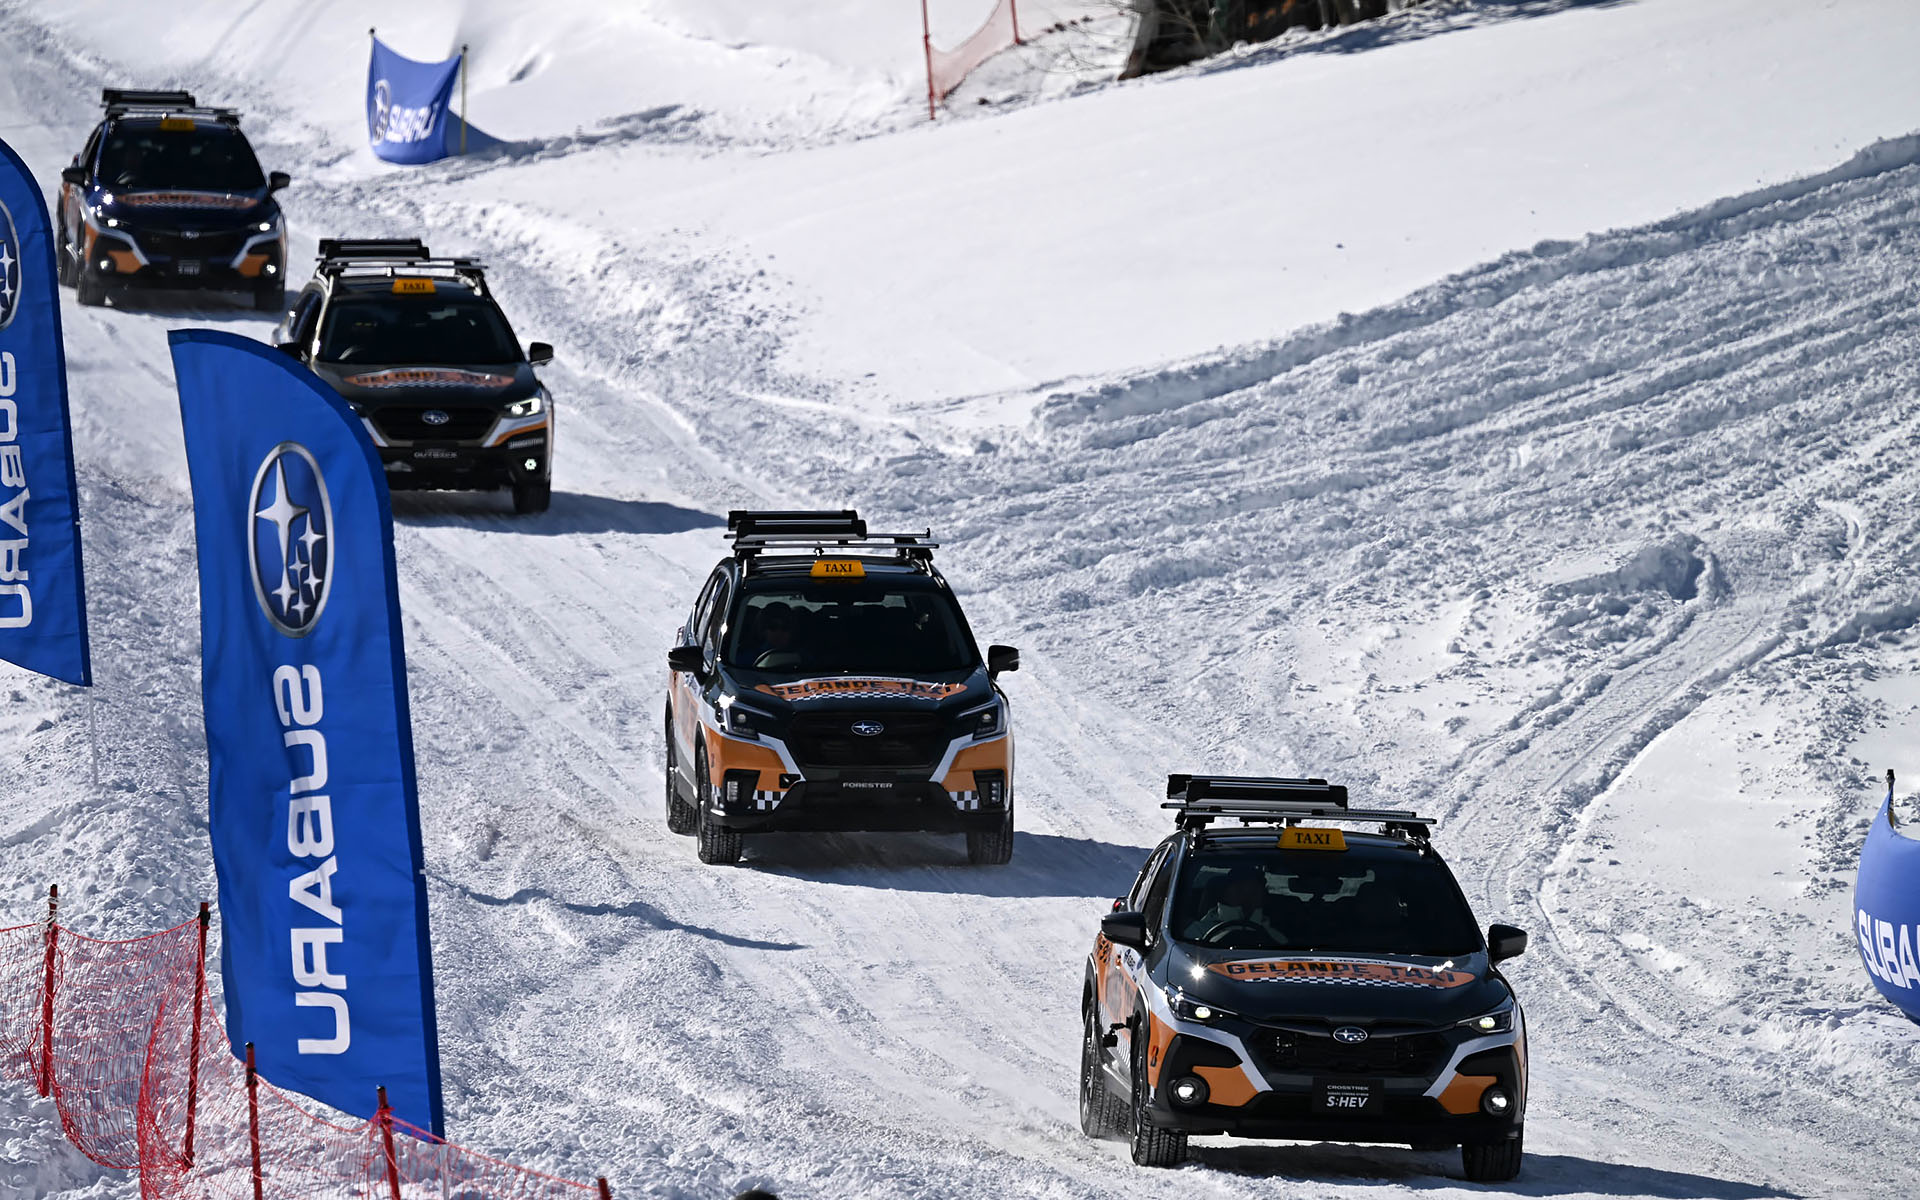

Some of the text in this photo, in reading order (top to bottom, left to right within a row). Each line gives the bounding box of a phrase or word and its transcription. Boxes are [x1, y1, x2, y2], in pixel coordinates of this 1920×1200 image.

[385, 101, 440, 143] SUBARU
[403, 282, 425, 291] TAXI
[824, 563, 853, 573] TAXI
[1295, 832, 1330, 844] TAXI
[1858, 908, 1920, 990] SUBA
[1226, 962, 1371, 976] GELANDE
[1383, 966, 1456, 983] TAXI
[1326, 1095, 1369, 1108] S:HEV
